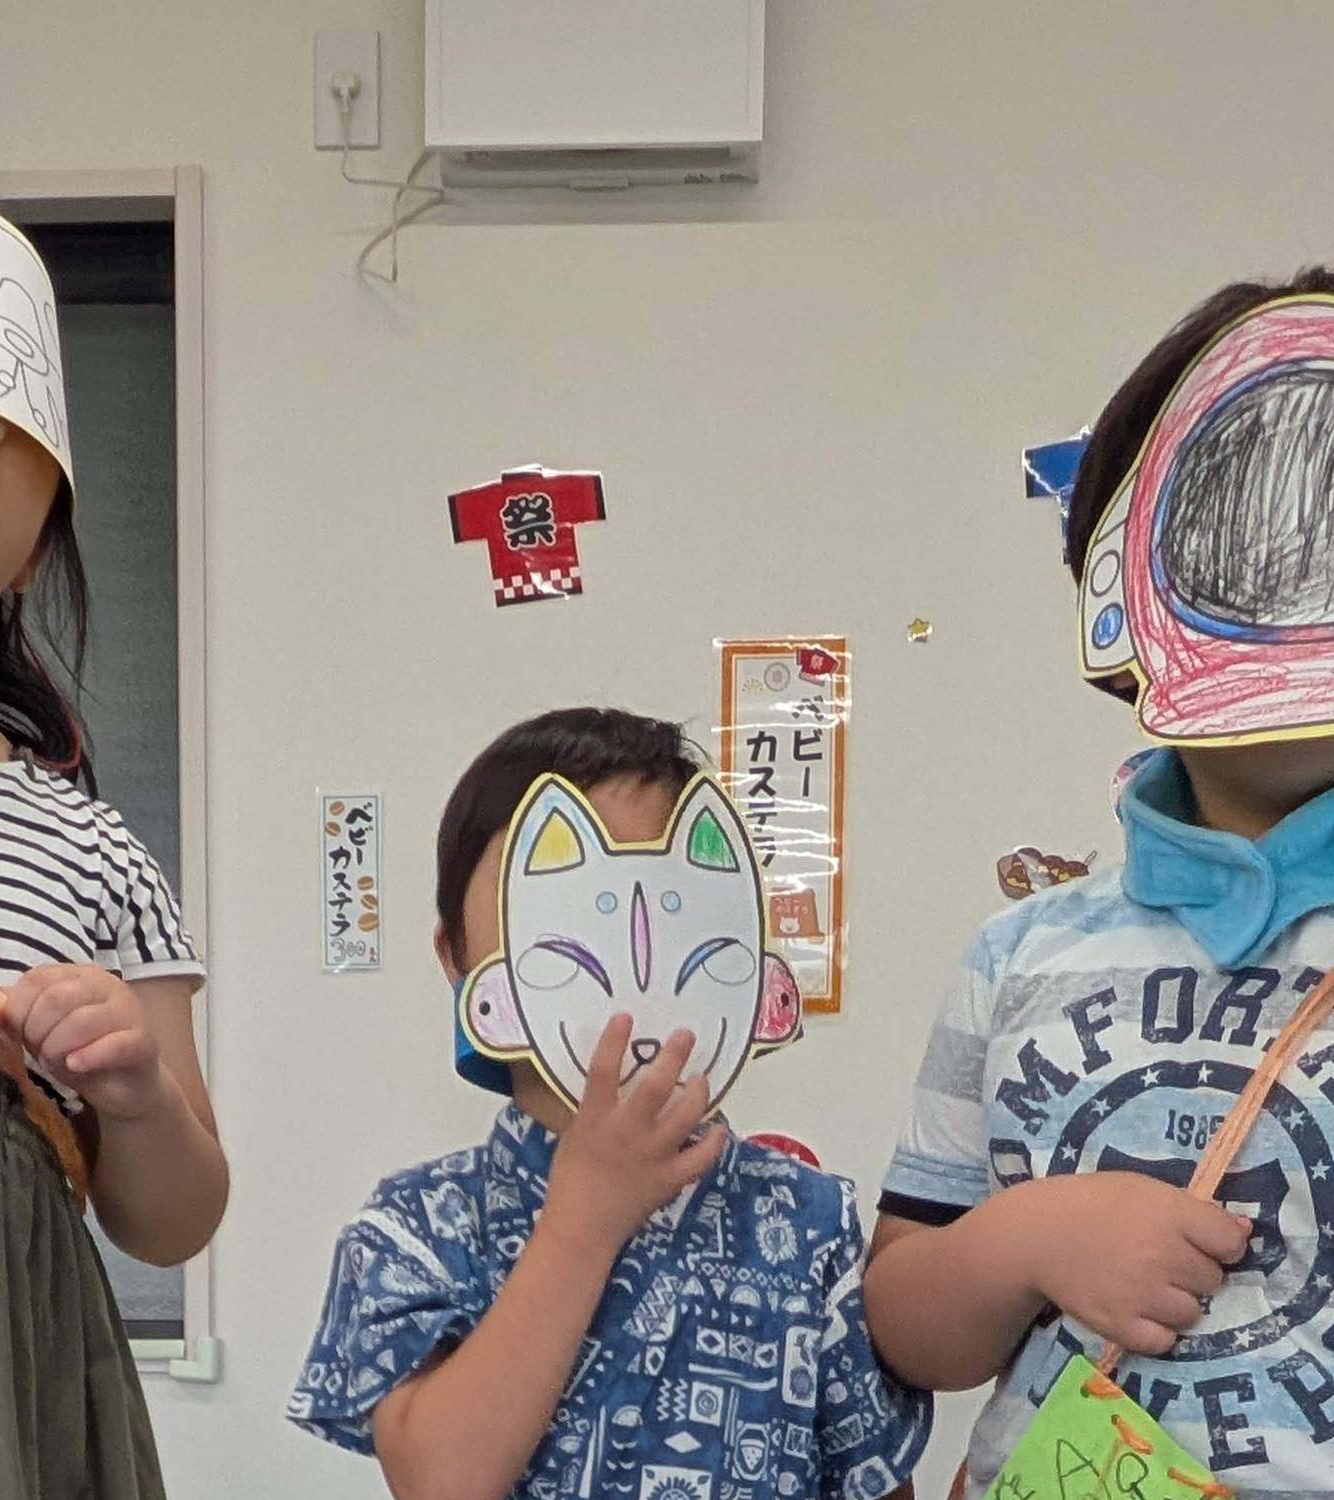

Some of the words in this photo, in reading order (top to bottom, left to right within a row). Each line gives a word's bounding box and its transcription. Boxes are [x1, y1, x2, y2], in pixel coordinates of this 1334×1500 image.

[501, 493, 555, 549] 祭
[791, 695, 823, 798] ベビー
[344, 801, 374, 866] ベビー
[745, 730, 778, 869] カステラ
[328, 845, 354, 937] カステラ
